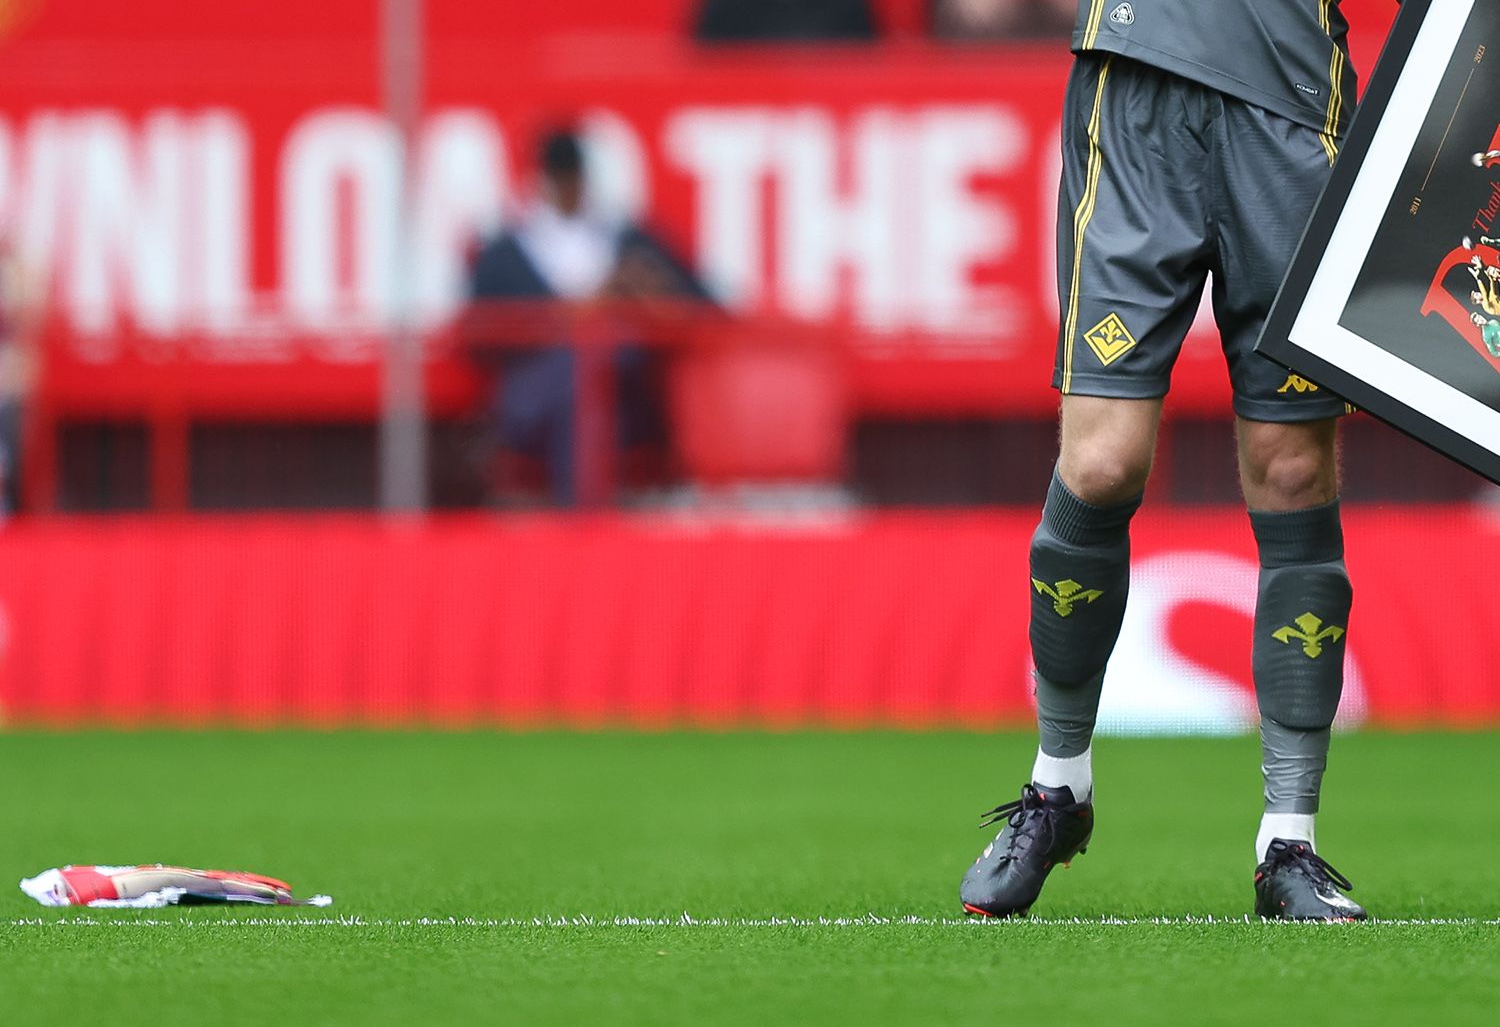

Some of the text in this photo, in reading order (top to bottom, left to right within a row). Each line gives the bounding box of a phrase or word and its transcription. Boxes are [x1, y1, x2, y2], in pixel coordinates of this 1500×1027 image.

[1473, 44, 1486, 64] 2023
[1409, 196, 1423, 216] 2011
[662, 104, 1030, 336] THE
